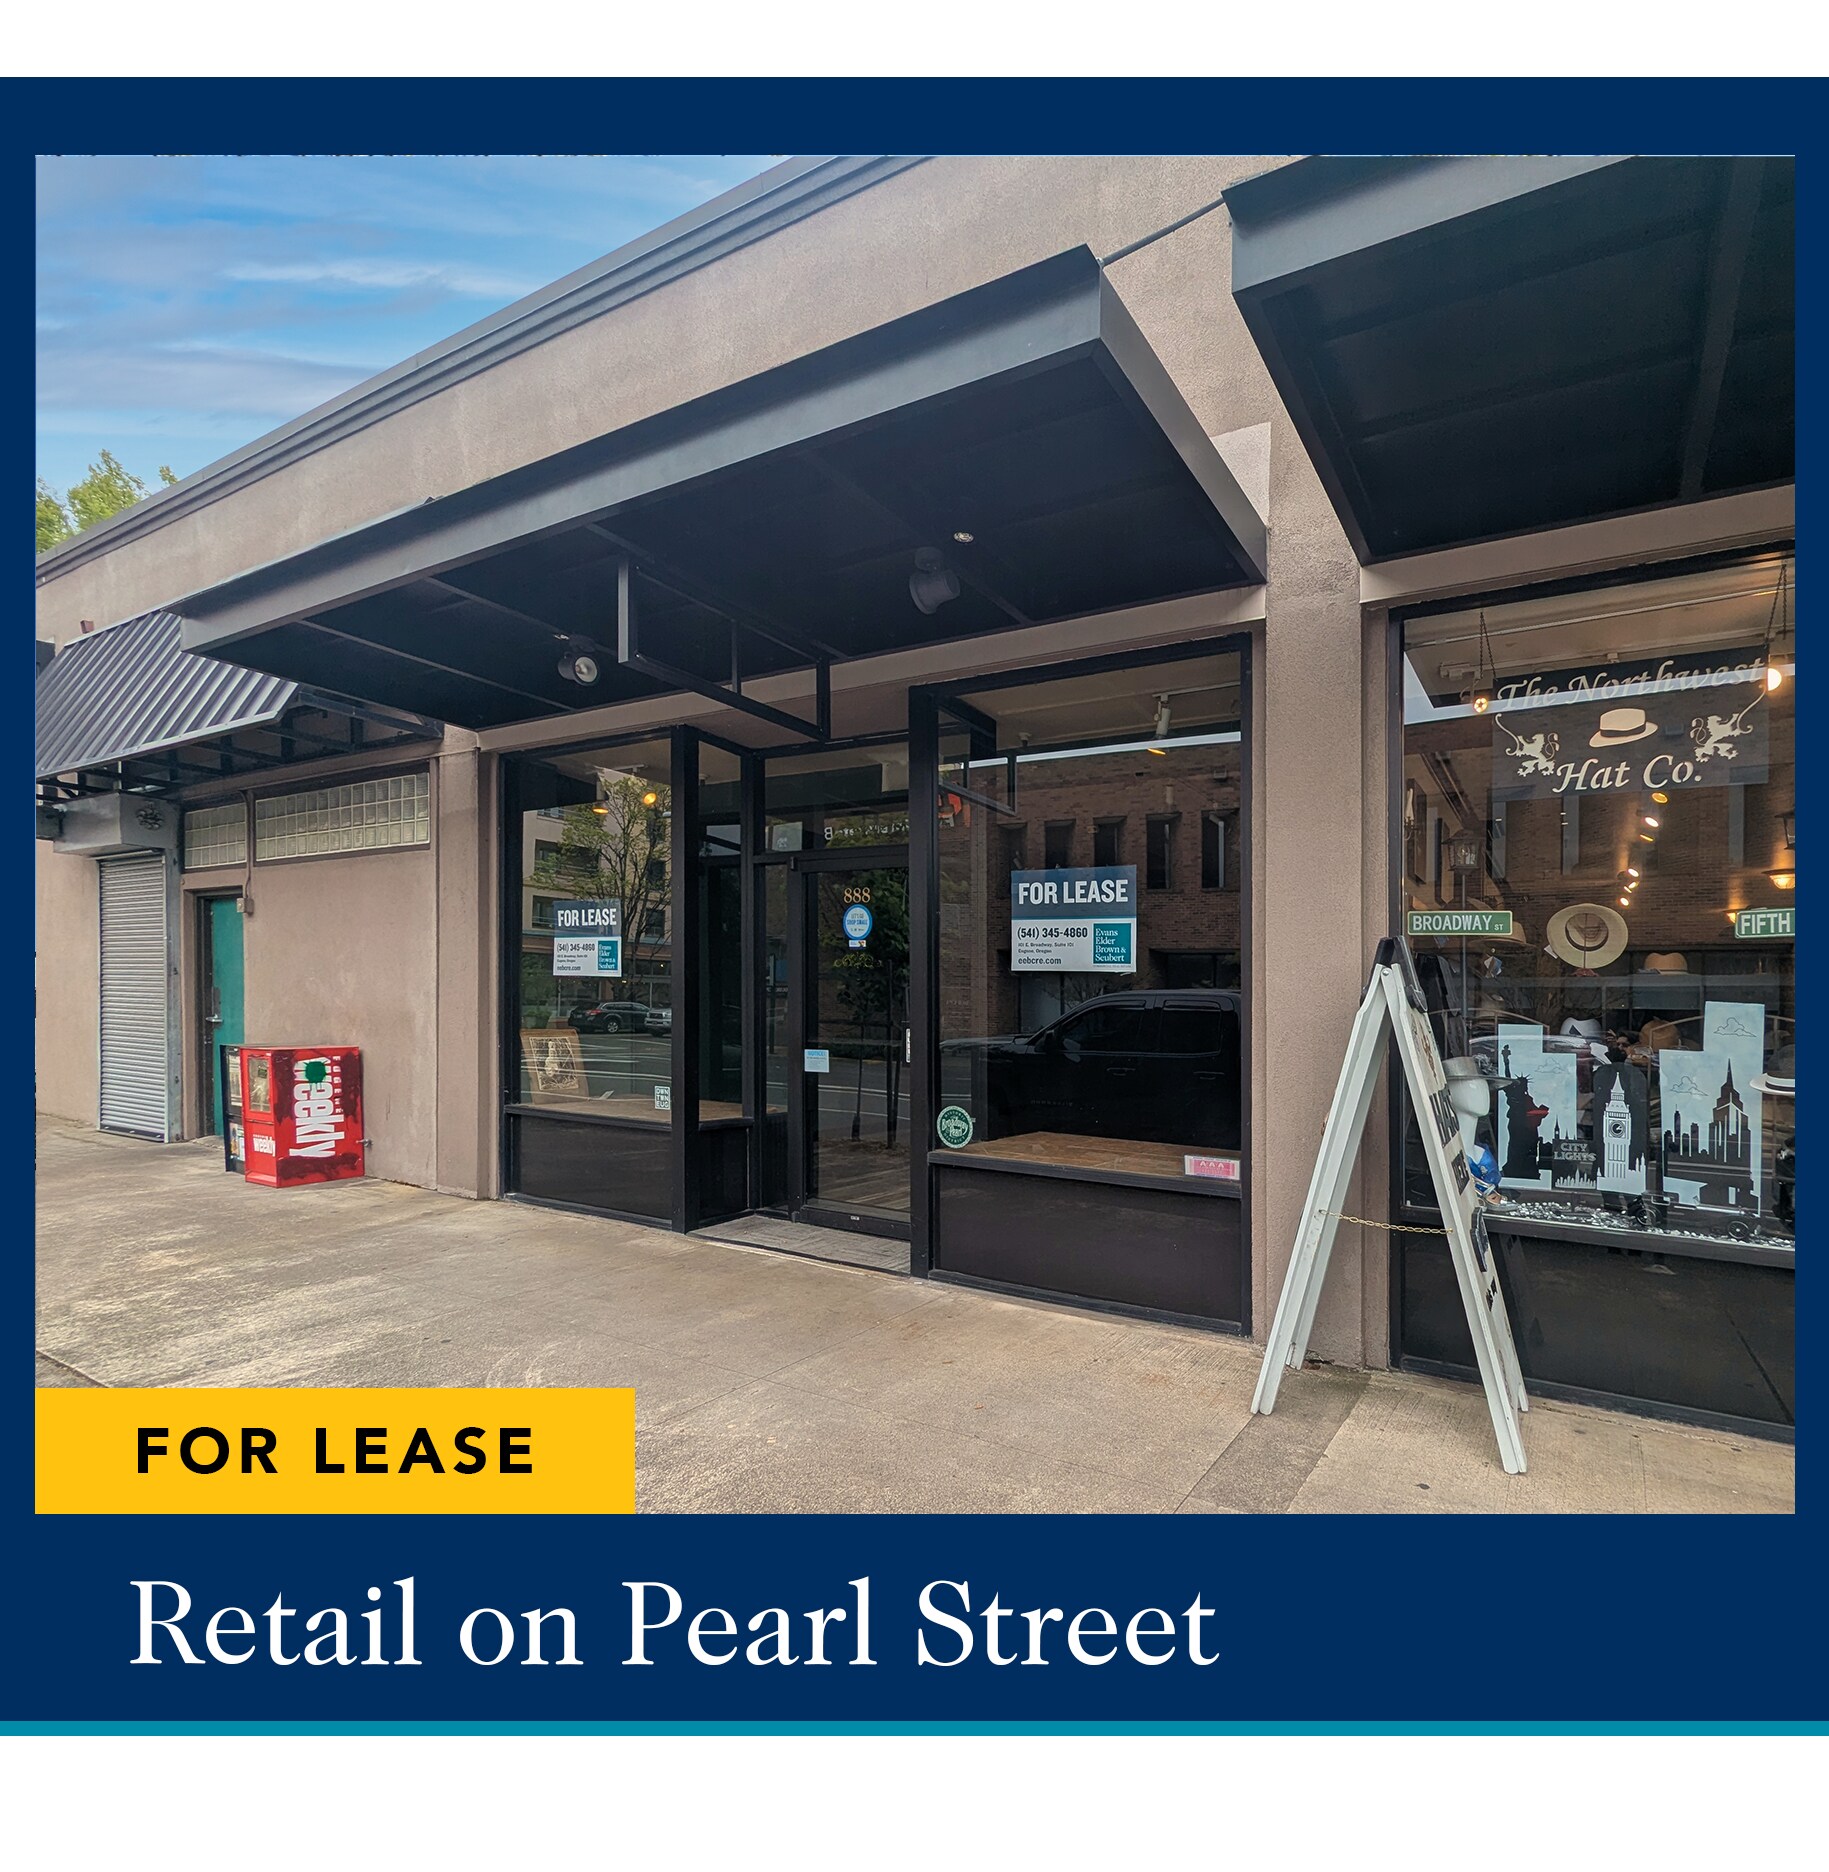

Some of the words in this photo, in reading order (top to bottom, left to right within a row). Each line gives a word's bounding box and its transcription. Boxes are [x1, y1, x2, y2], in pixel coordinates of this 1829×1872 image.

[1497, 676, 1558, 711] The
[1568, 657, 1765, 704] Northwest
[1552, 758, 1630, 793] Hat
[1643, 755, 1702, 789] Co.
[844, 887, 870, 903] 888
[1019, 882, 1058, 905] FOR
[1063, 880, 1128, 904] LEASE
[557, 909, 579, 927] FOR
[582, 908, 617, 926] LEASE
[1412, 915, 1492, 931] BROADWAY
[1494, 923, 1504, 931] ST
[1741, 912, 1791, 935] FIFTH
[1017, 926, 1040, 940] (541)
[1042, 927, 1088, 938] 345-4860
[1095, 928, 1119, 936] Evans
[1095, 937, 1116, 945] Elder
[1095, 945, 1120, 954] Brown
[1018, 957, 1062, 965] eebcre.com
[1095, 954, 1125, 963] Seubert
[1560, 1142, 1588, 1152] CITY
[1553, 1151, 1597, 1162] LIGHTS
